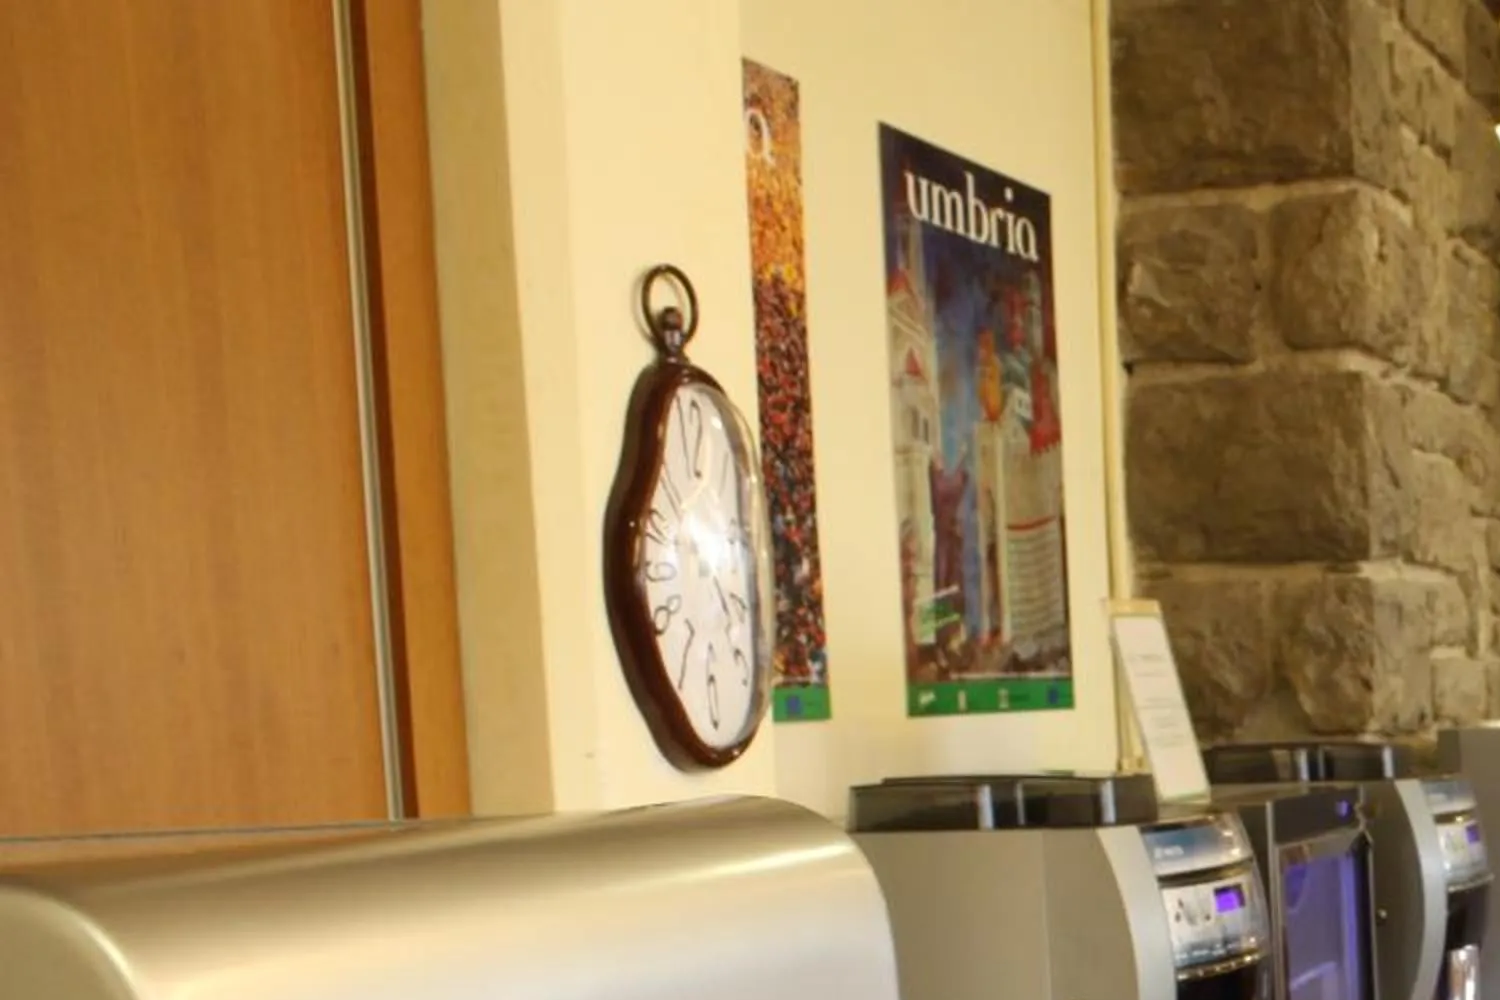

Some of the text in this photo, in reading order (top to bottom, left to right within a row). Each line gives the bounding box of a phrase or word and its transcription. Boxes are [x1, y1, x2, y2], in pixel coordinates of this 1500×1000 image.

[904, 169, 1039, 262] umbria
[676, 392, 703, 480] 12
[653, 594, 682, 636] 8
